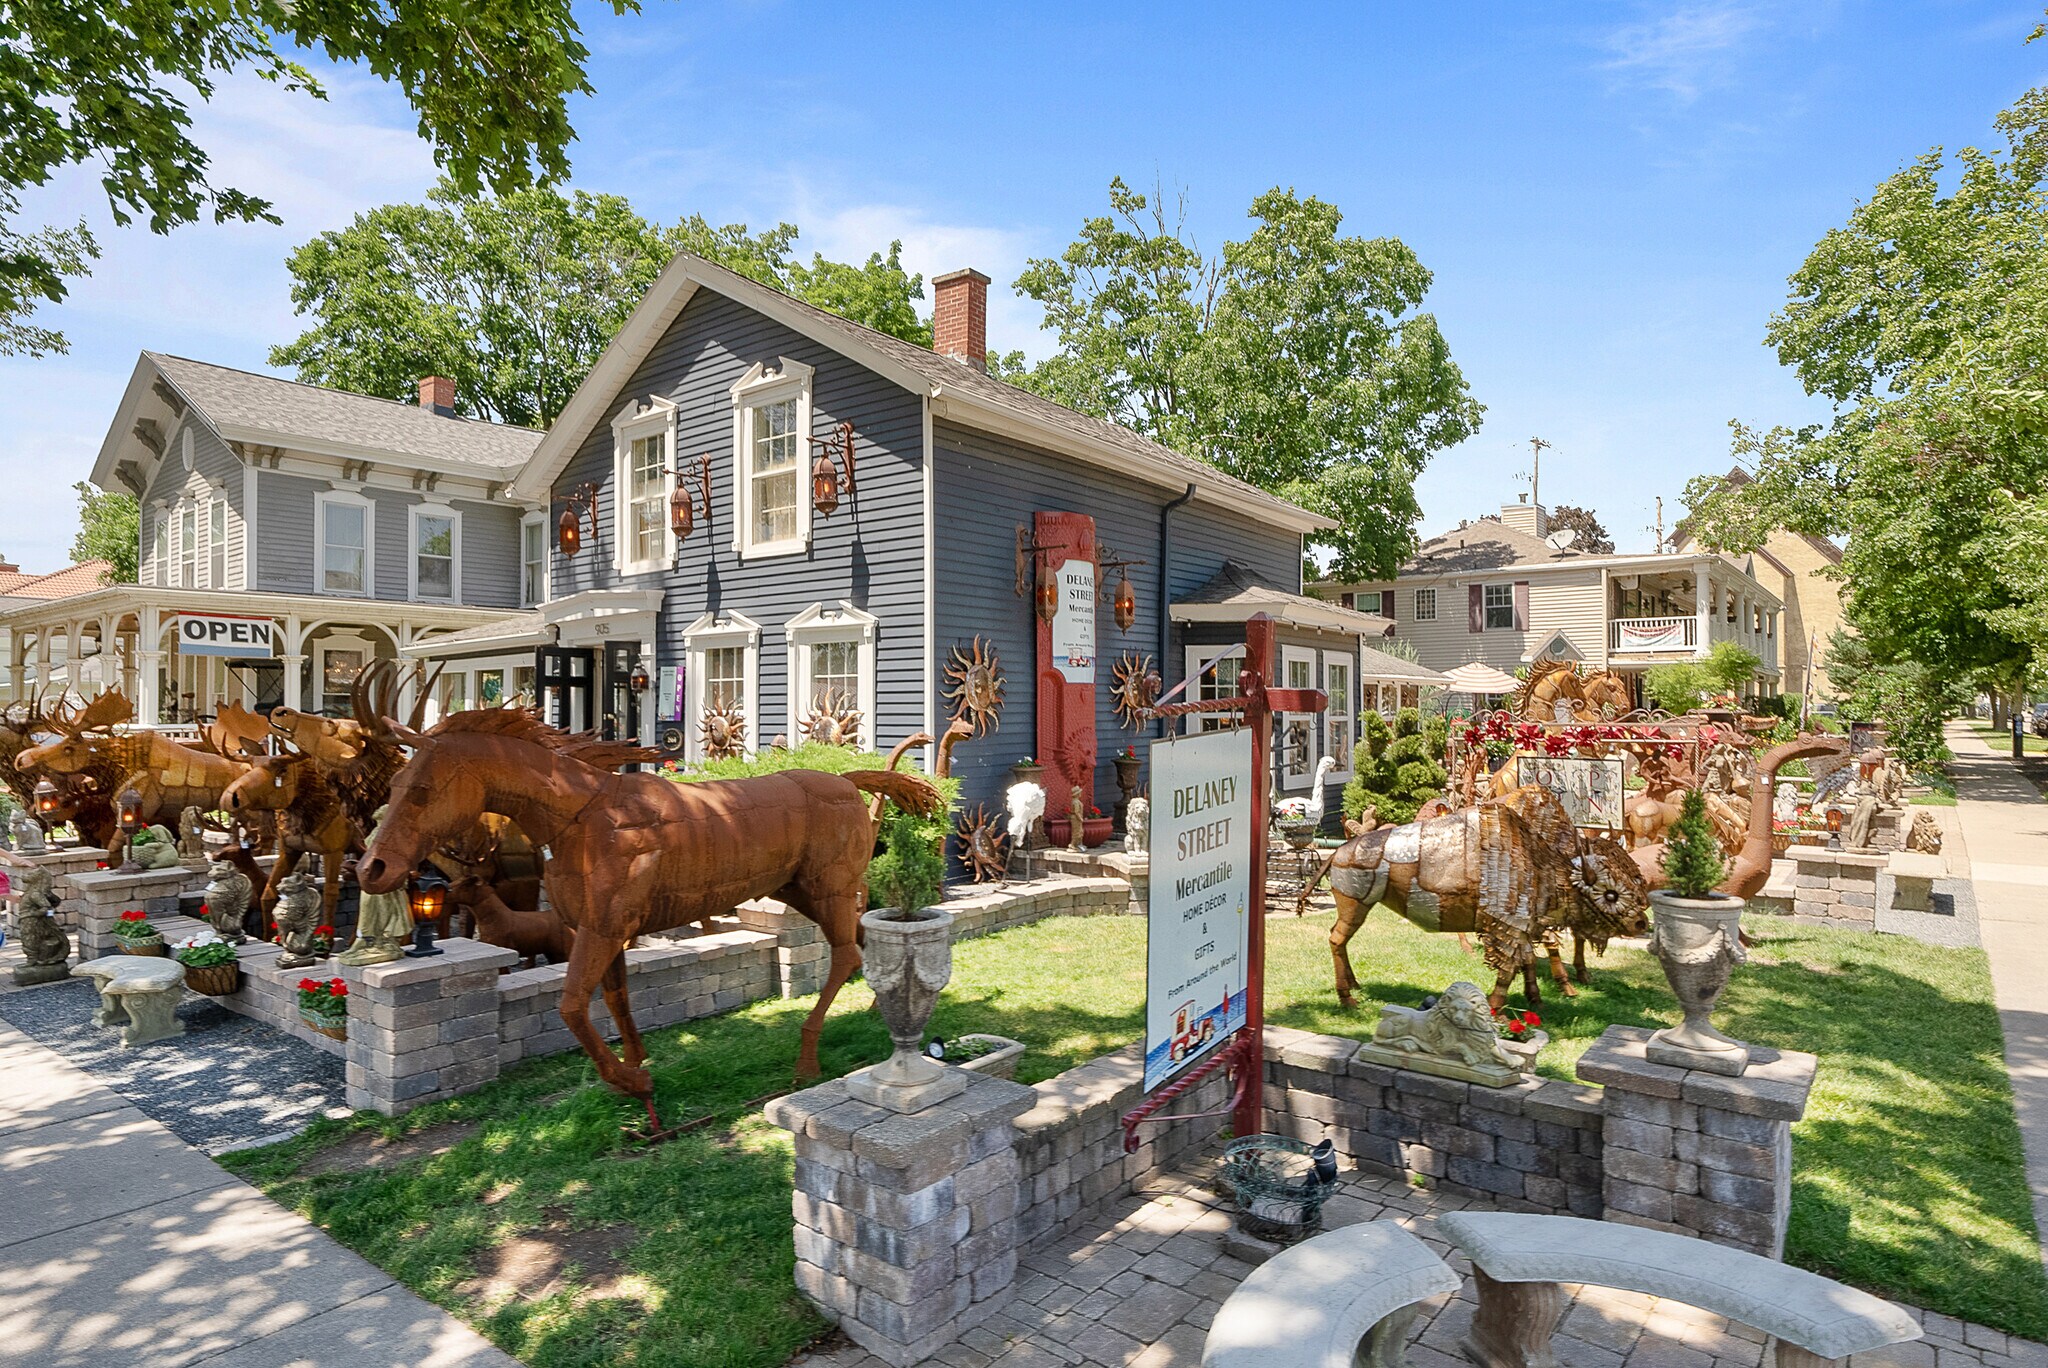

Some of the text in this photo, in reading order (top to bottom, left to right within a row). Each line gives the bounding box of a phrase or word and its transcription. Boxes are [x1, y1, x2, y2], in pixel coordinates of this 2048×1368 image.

[183, 619, 270, 645] OPEN
[594, 622, 610, 636] 905
[675, 673, 683, 713] OPEN
[1173, 775, 1238, 819] DELANEY
[1177, 817, 1232, 862] STREET
[1175, 860, 1233, 902] Mercantile
[1183, 893, 1228, 923] HOME DÉCOR
[1202, 922, 1208, 935] &
[1194, 940, 1215, 961] GIFTS
[1168, 952, 1238, 1000] From Around the World
